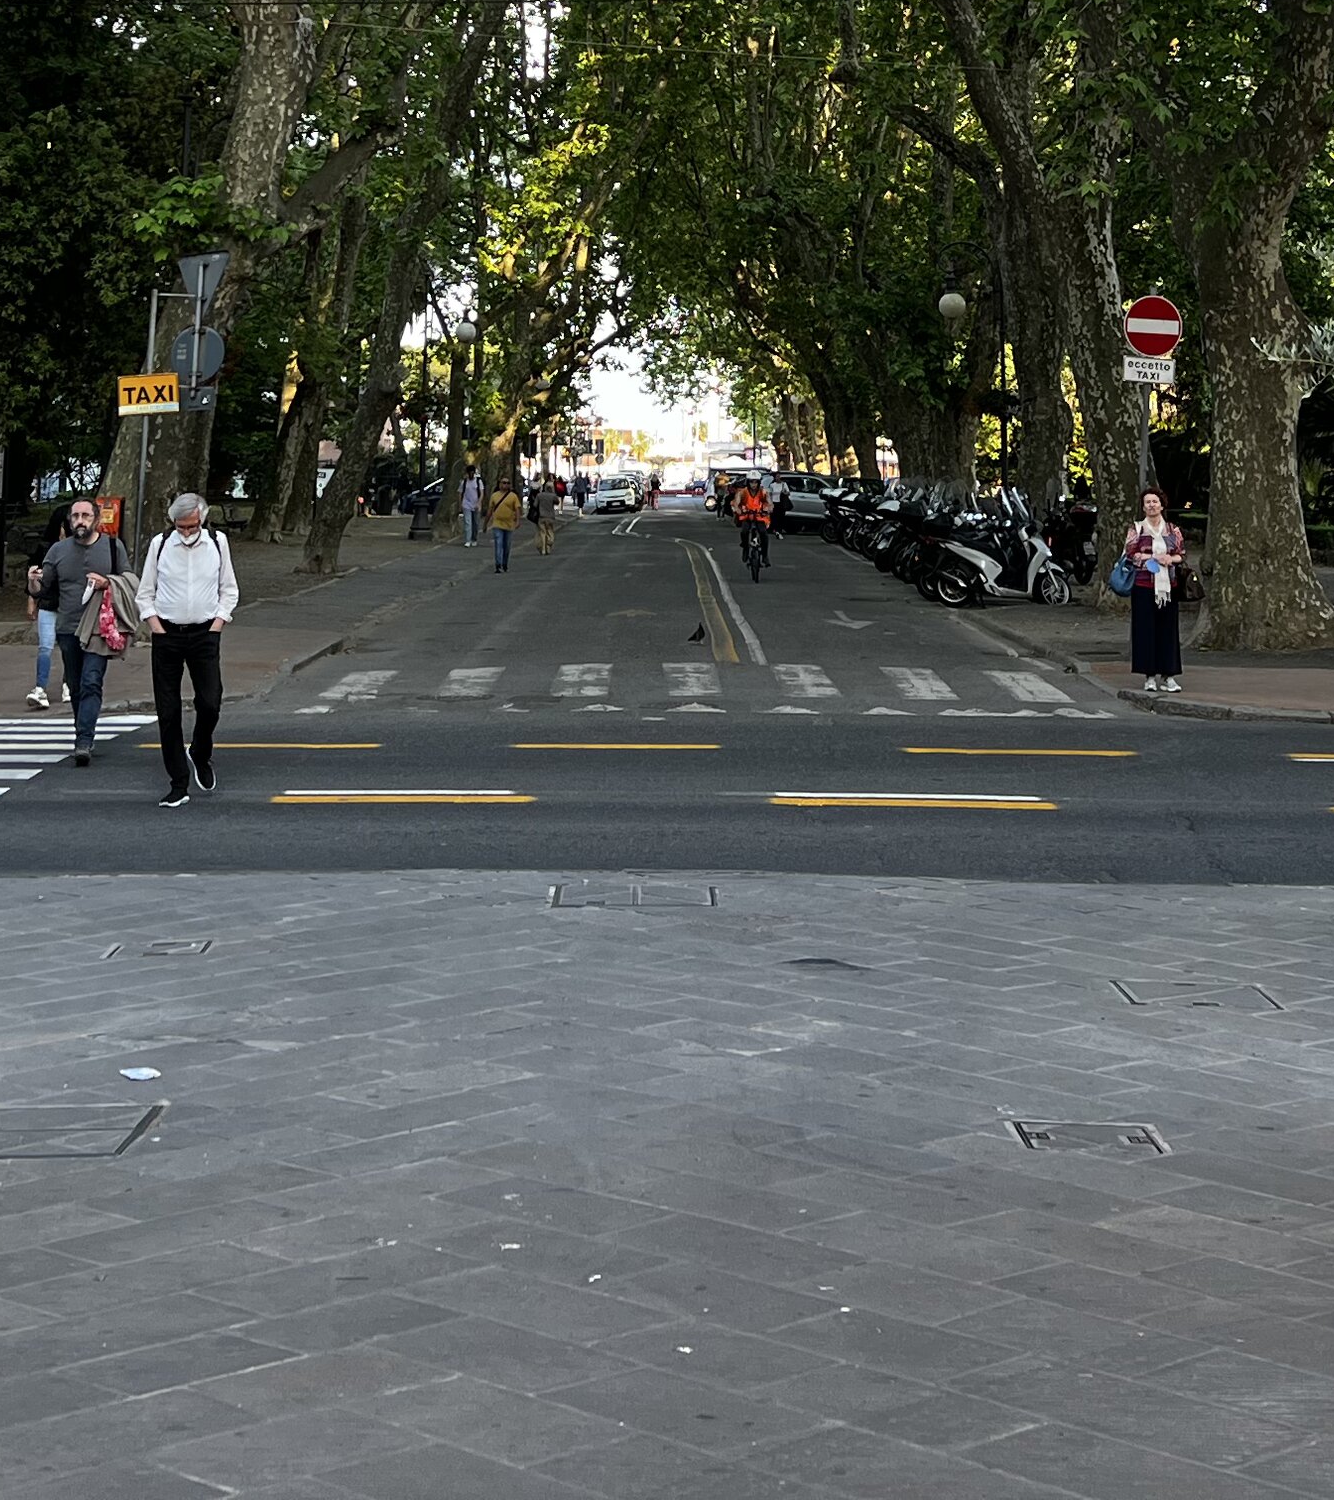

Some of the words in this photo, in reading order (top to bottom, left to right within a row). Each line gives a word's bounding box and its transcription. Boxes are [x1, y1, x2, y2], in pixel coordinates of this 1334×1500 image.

[1128, 360, 1171, 371] eccetto
[1137, 371, 1160, 381] TAXI
[123, 385, 174, 405] TAXI
